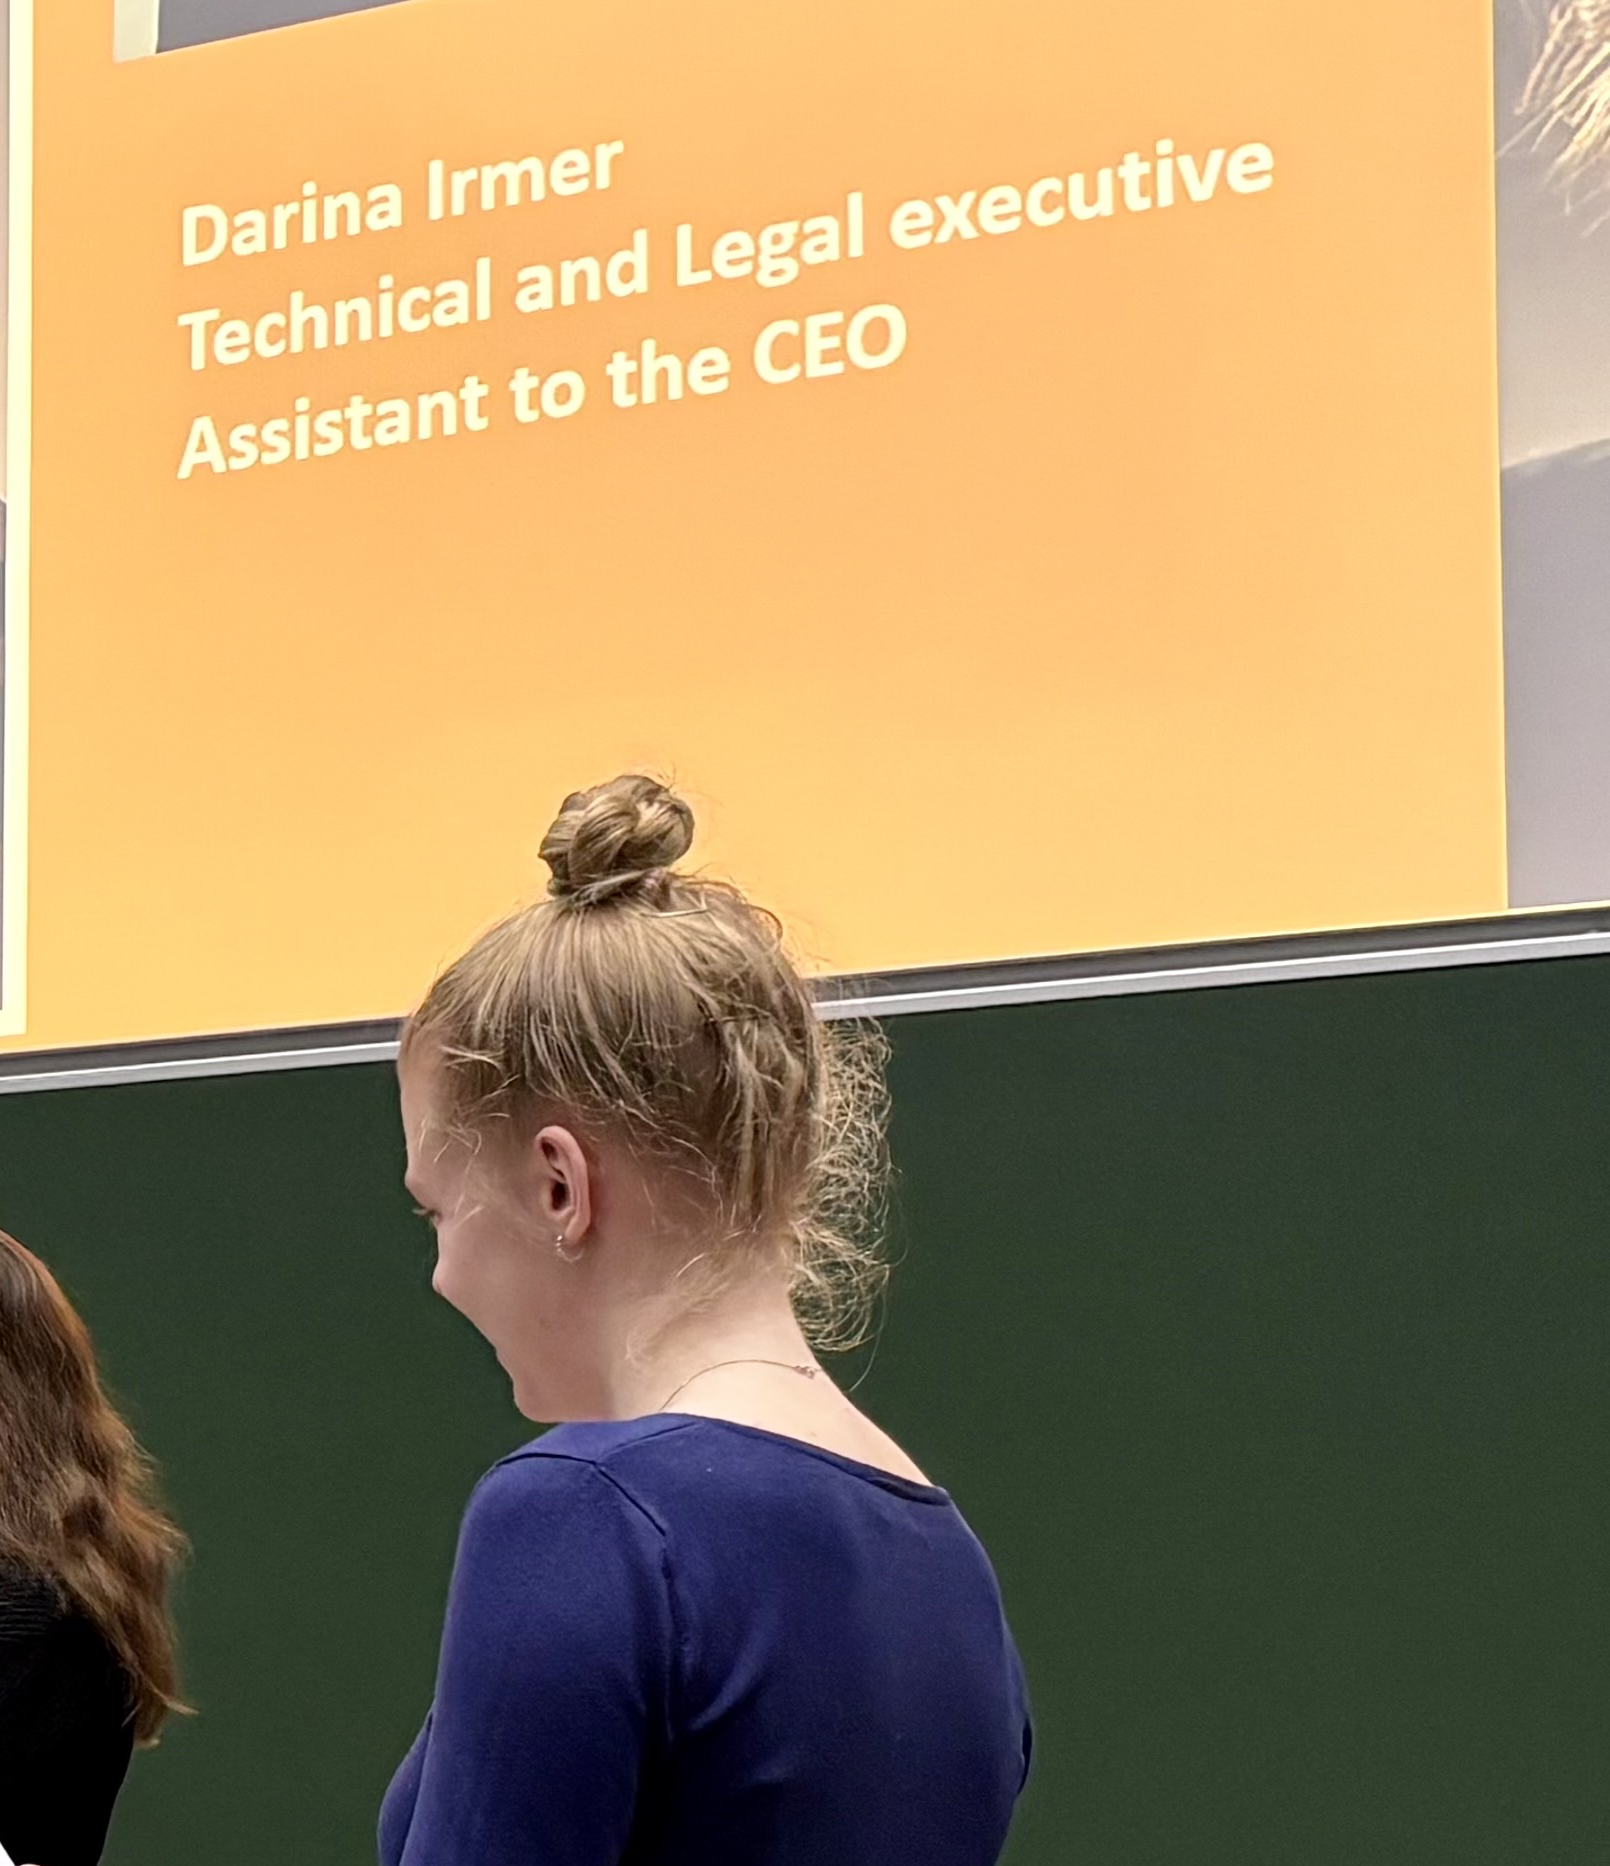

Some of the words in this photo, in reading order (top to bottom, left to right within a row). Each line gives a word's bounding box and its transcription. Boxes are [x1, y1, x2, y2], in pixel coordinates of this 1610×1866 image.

[177, 258, 492, 372] Technical
[514, 229, 649, 314] and
[675, 192, 864, 288] Legal
[888, 138, 1274, 251] executive
[180, 181, 403, 267] Darina
[427, 138, 624, 222] Irmer
[177, 374, 489, 480] Assistant
[508, 364, 584, 424] to
[606, 336, 731, 410] the
[753, 302, 908, 383] CEO
